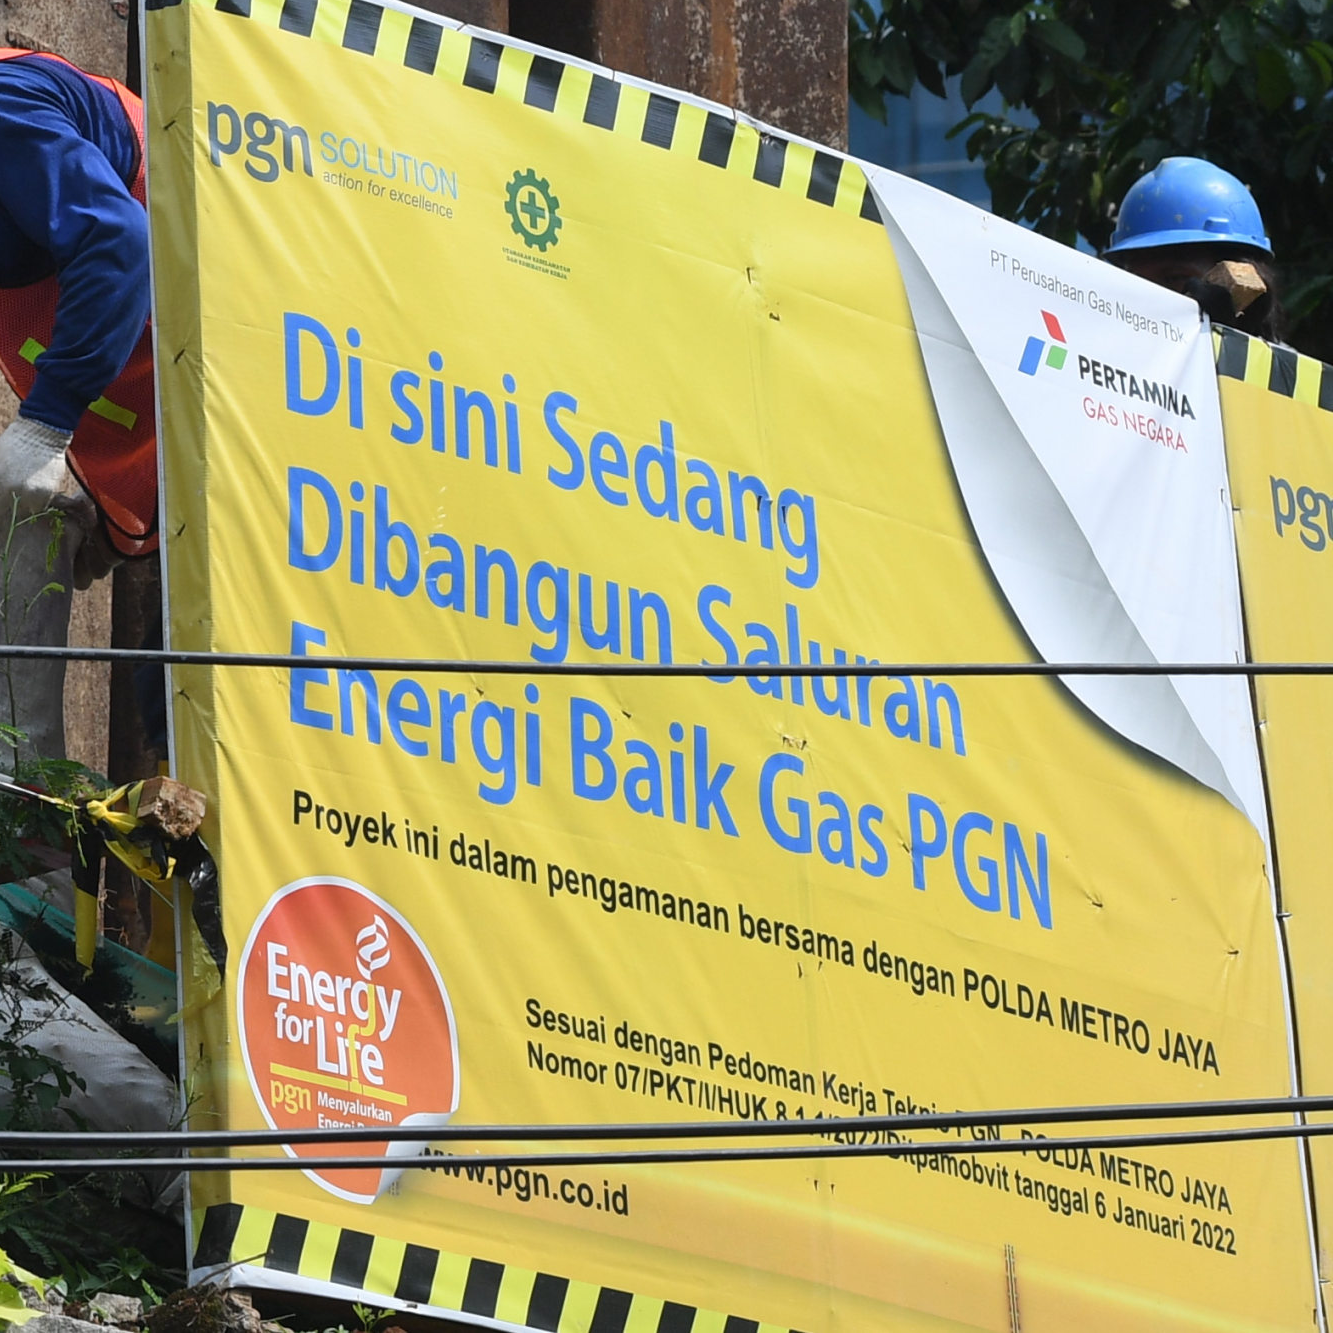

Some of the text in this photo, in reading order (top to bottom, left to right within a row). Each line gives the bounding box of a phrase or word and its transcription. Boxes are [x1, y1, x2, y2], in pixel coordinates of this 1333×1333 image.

[207, 101, 458, 200] pgn SOLUTION
[323, 170, 454, 219] action for excellence
[990, 250, 1008, 272] PT
[1012, 258, 1084, 304] Perusahaan
[1088, 291, 1112, 316] Gas
[1116, 302, 1158, 335] Negara
[1078, 354, 1196, 419] PERTAMINA
[1083, 397, 1188, 453] GAS NEGARA
[284, 311, 820, 589] Di sini Sedang
[288, 467, 966, 757] Dibangun Saluran
[289, 620, 1054, 930] Energi Baik Gas PGN
[293, 789, 1219, 1076] Proyek ini dalam pengamanan bersama dengan POLDA METRO JAYA
[266, 942, 401, 1042] Energy
[274, 1003, 385, 1086] for Life
[270, 1080, 392, 1122] pgn Menyalurkan
[526, 999, 606, 1044] Sesuai
[615, 1019, 701, 1071] dengan
[708, 1043, 815, 1095] Pedoman
[822, 1070, 876, 1116] Kerja
[1021, 1129, 1095, 1176] POLDA
[1100, 1151, 1174, 1198] METRO
[1181, 1176, 1232, 1215] JAYA
[527, 1040, 607, 1084] Nomor
[1015, 1170, 1089, 1216] tanggal
[1095, 1191, 1106, 1218] 6
[1113, 1197, 1186, 1241] Januari
[1191, 1218, 1237, 1255] 2022
